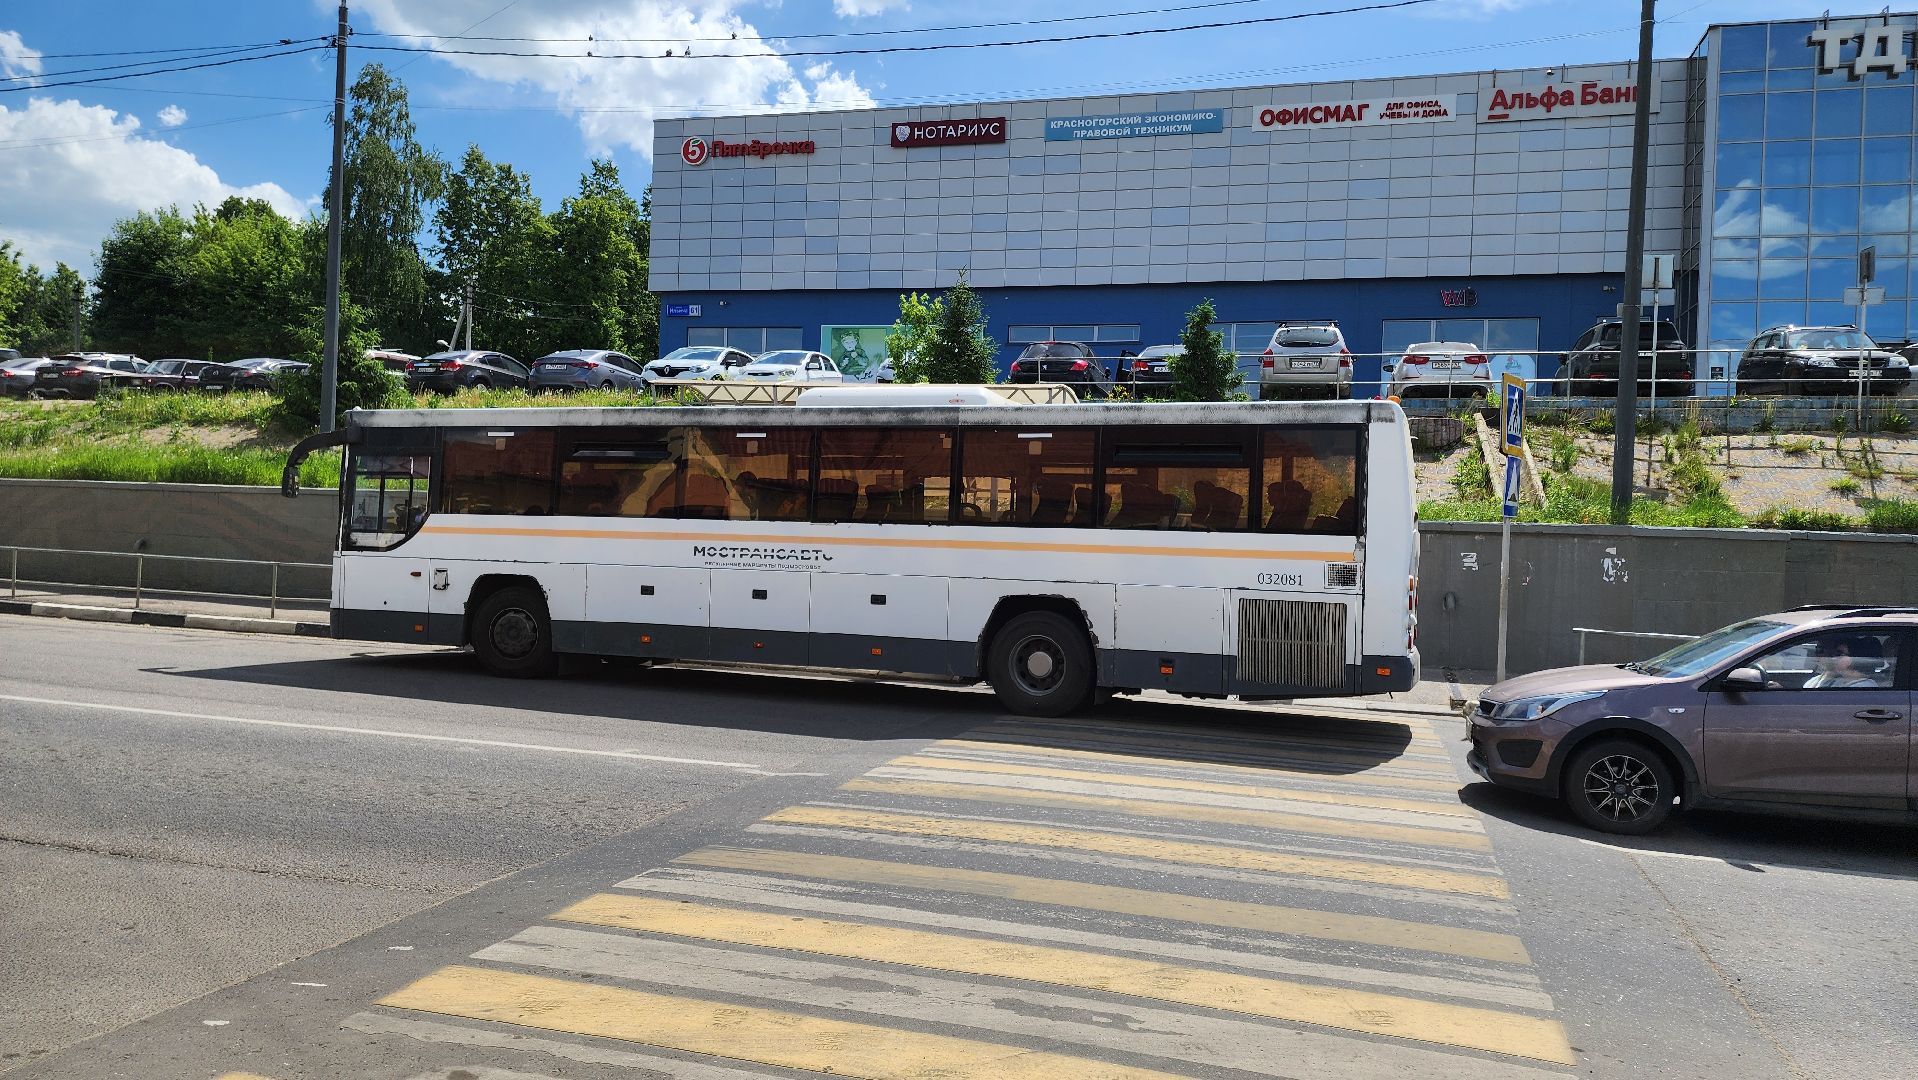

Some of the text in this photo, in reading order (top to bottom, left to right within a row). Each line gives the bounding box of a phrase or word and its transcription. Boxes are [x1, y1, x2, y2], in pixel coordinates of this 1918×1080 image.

[1386, 100, 1442, 111] ДЛЯ ОФИСА,
[1489, 86, 1575, 113] Альфа
[1050, 112, 1217, 129] КРАСНОГОРСКИЙ ЭКОНОМИКО-
[1260, 103, 1369, 127] ОФИСМАГ
[1379, 108, 1449, 120] УЧЕБЫ И ДОМА
[914, 122, 1000, 139] НОТАРИУС
[1073, 124, 1192, 138] ПРАВОВОЙ ТЕХНИКУМ
[710, 140, 815, 160] Пятёрочка
[1257, 572, 1304, 586] 032081
